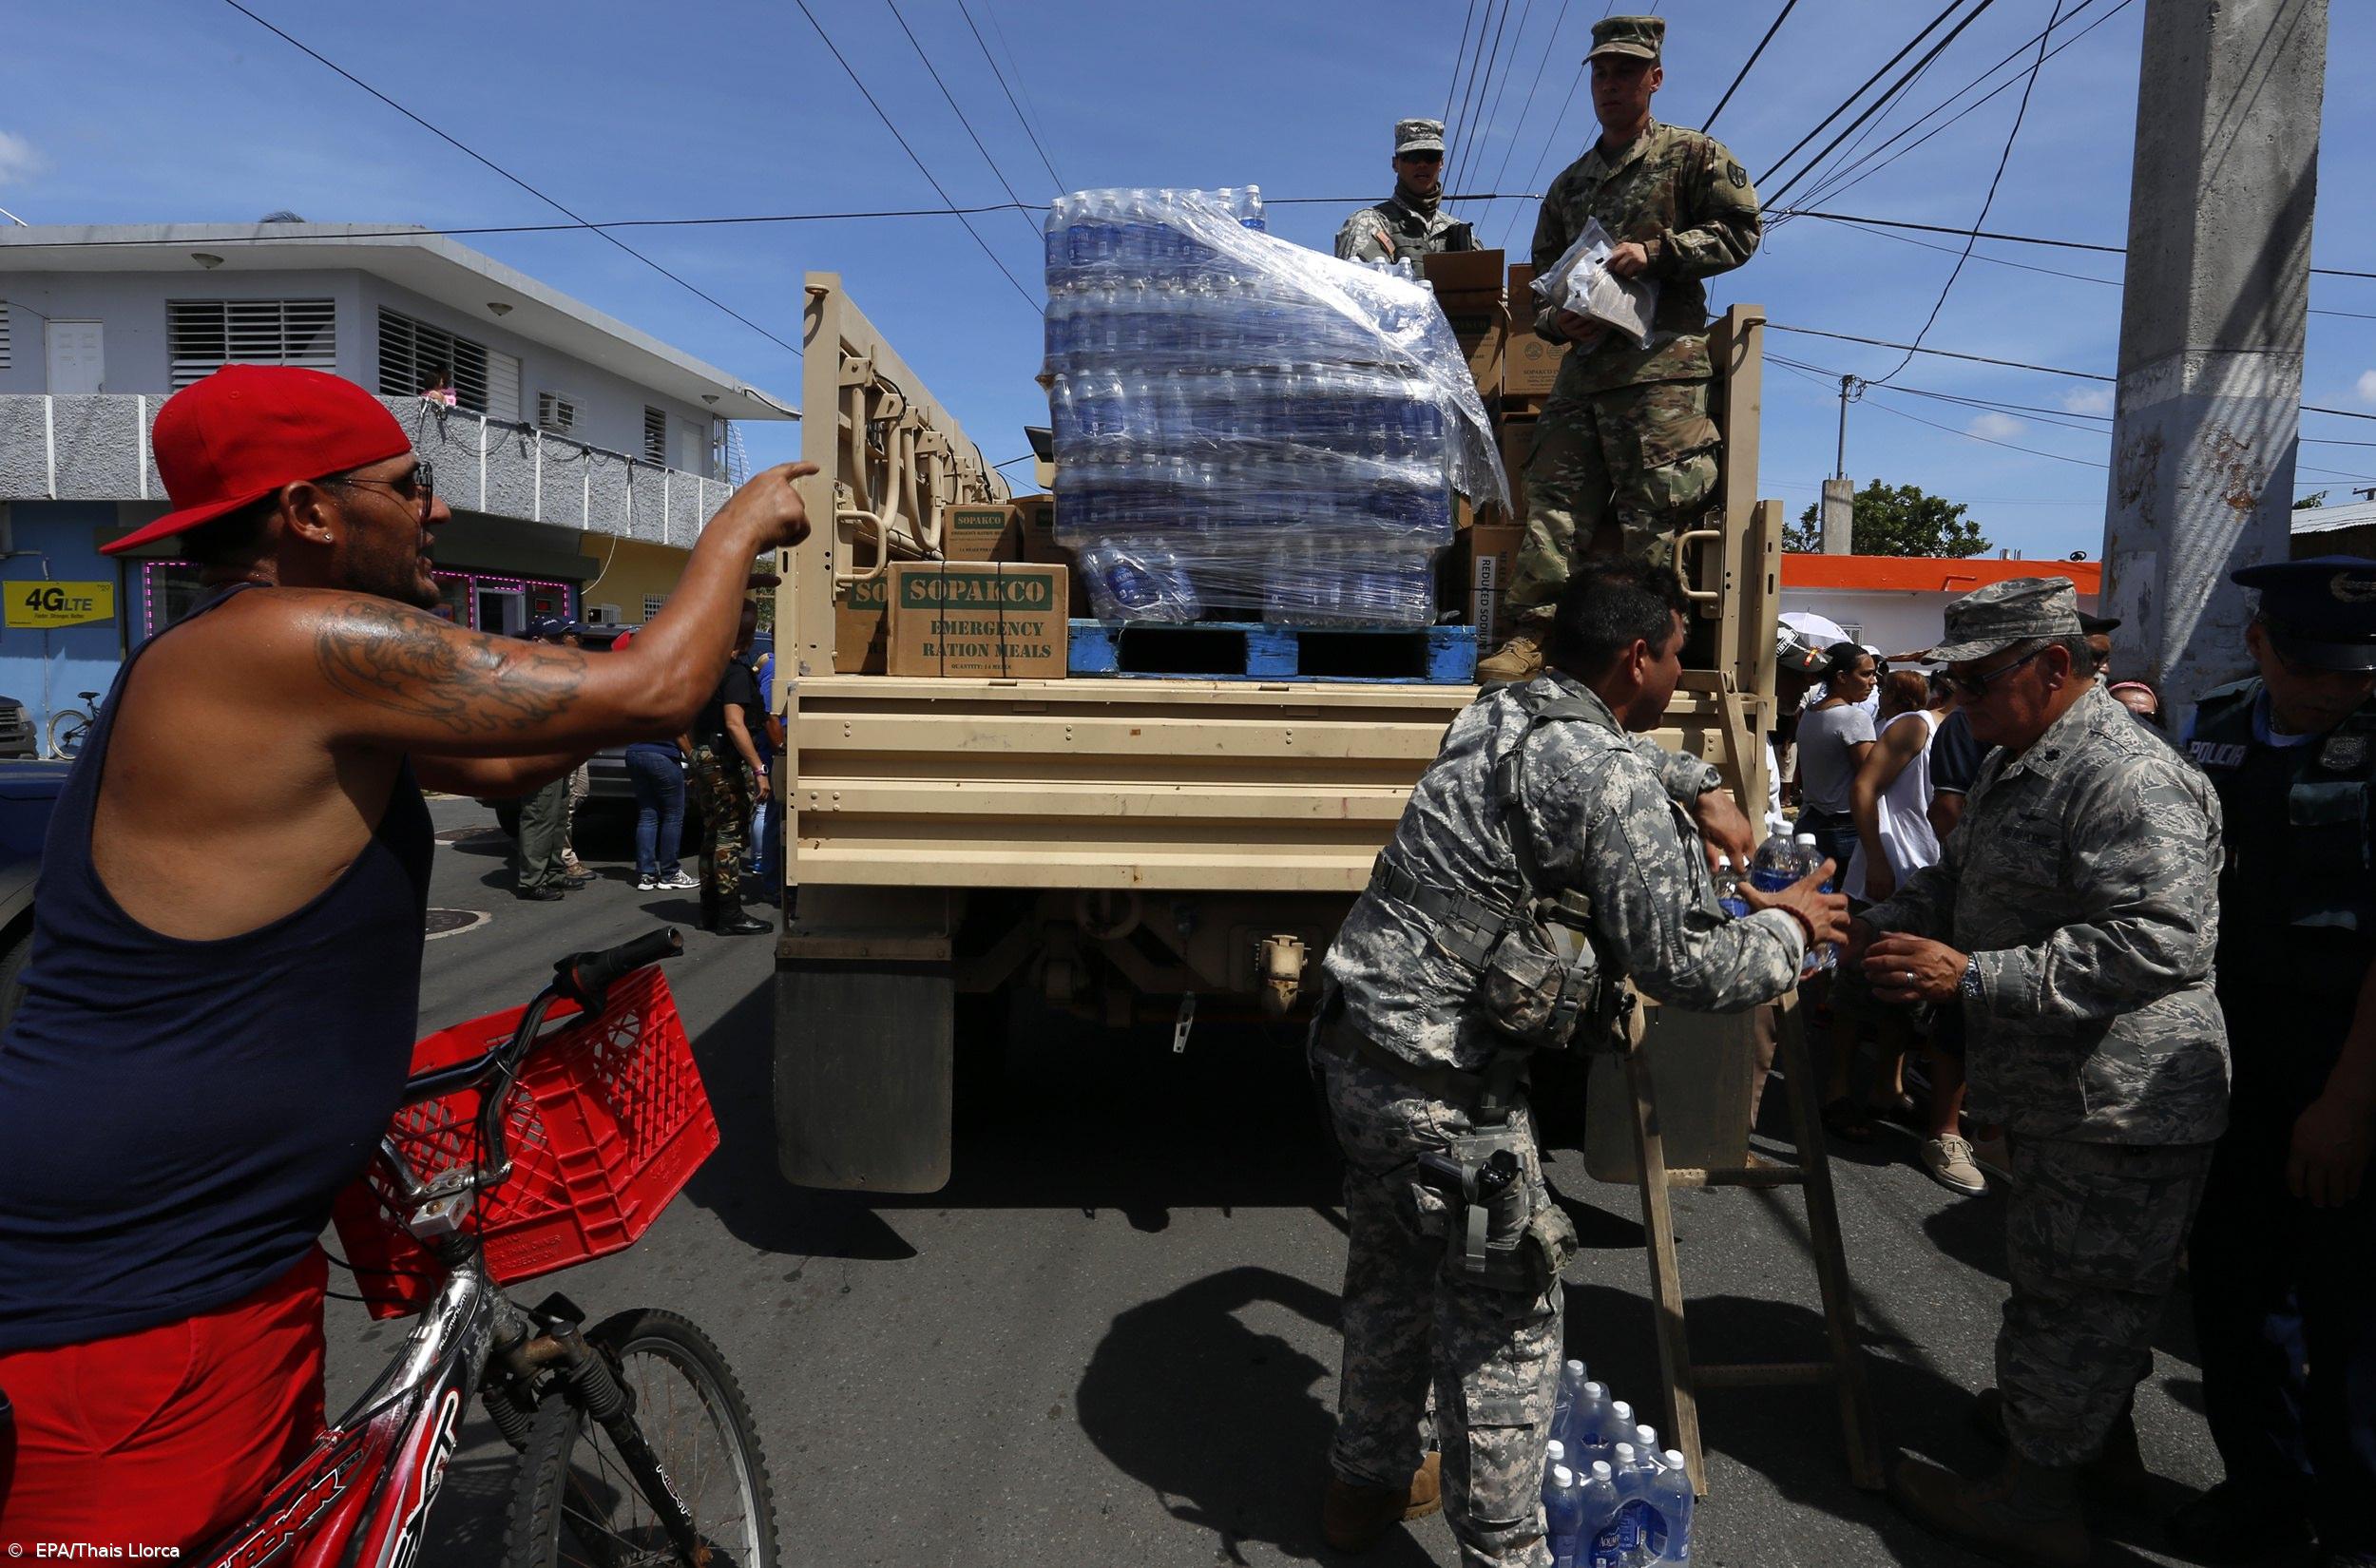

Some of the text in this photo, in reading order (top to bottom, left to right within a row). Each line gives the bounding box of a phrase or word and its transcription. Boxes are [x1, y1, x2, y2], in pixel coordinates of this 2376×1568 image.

[957, 516, 1001, 526] SOPAKCO
[910, 579, 1045, 602] SOPAKCO
[1478, 559, 1491, 651] REDUCED SODIUM
[930, 620, 1044, 637] EMERGENCY
[922, 642, 1052, 659] RATION MEALS
